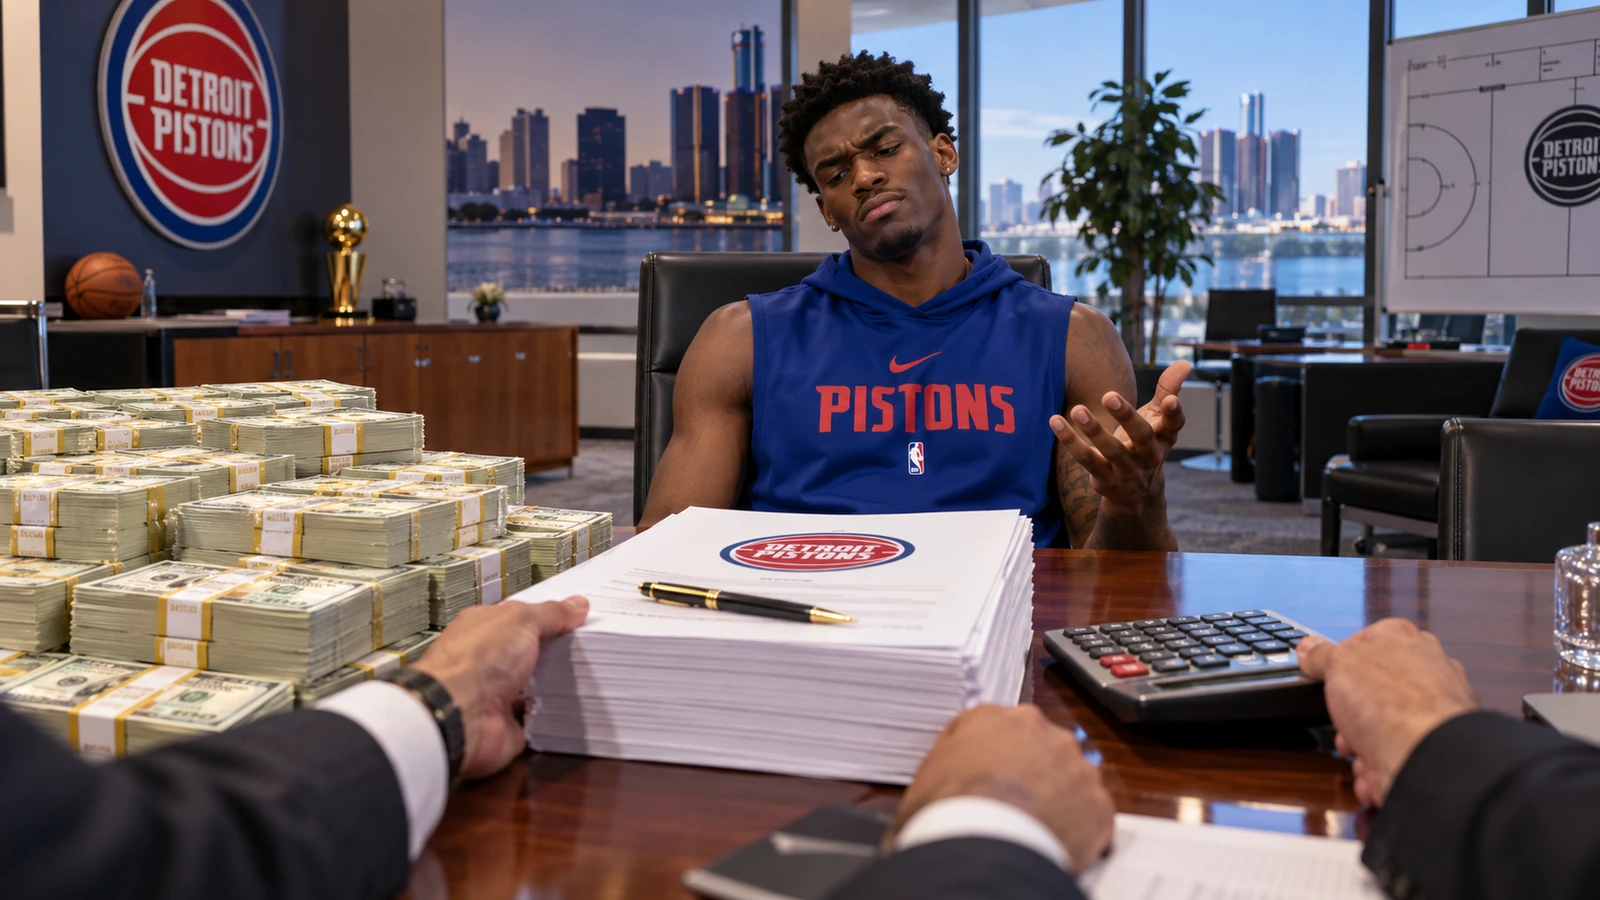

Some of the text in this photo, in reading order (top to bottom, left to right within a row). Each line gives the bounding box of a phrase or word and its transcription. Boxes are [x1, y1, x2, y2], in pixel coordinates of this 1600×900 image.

[150, 57, 254, 120] DETROIT
[150, 105, 254, 164] PISTONS
[1542, 136, 1600, 158] DETROI
[1541, 155, 1600, 177] PISTON
[1569, 377, 1600, 393] PISTO
[815, 383, 1016, 434] PISTONS
[752, 550, 876, 560] PISTONS
[764, 543, 881, 553] DETROIT
